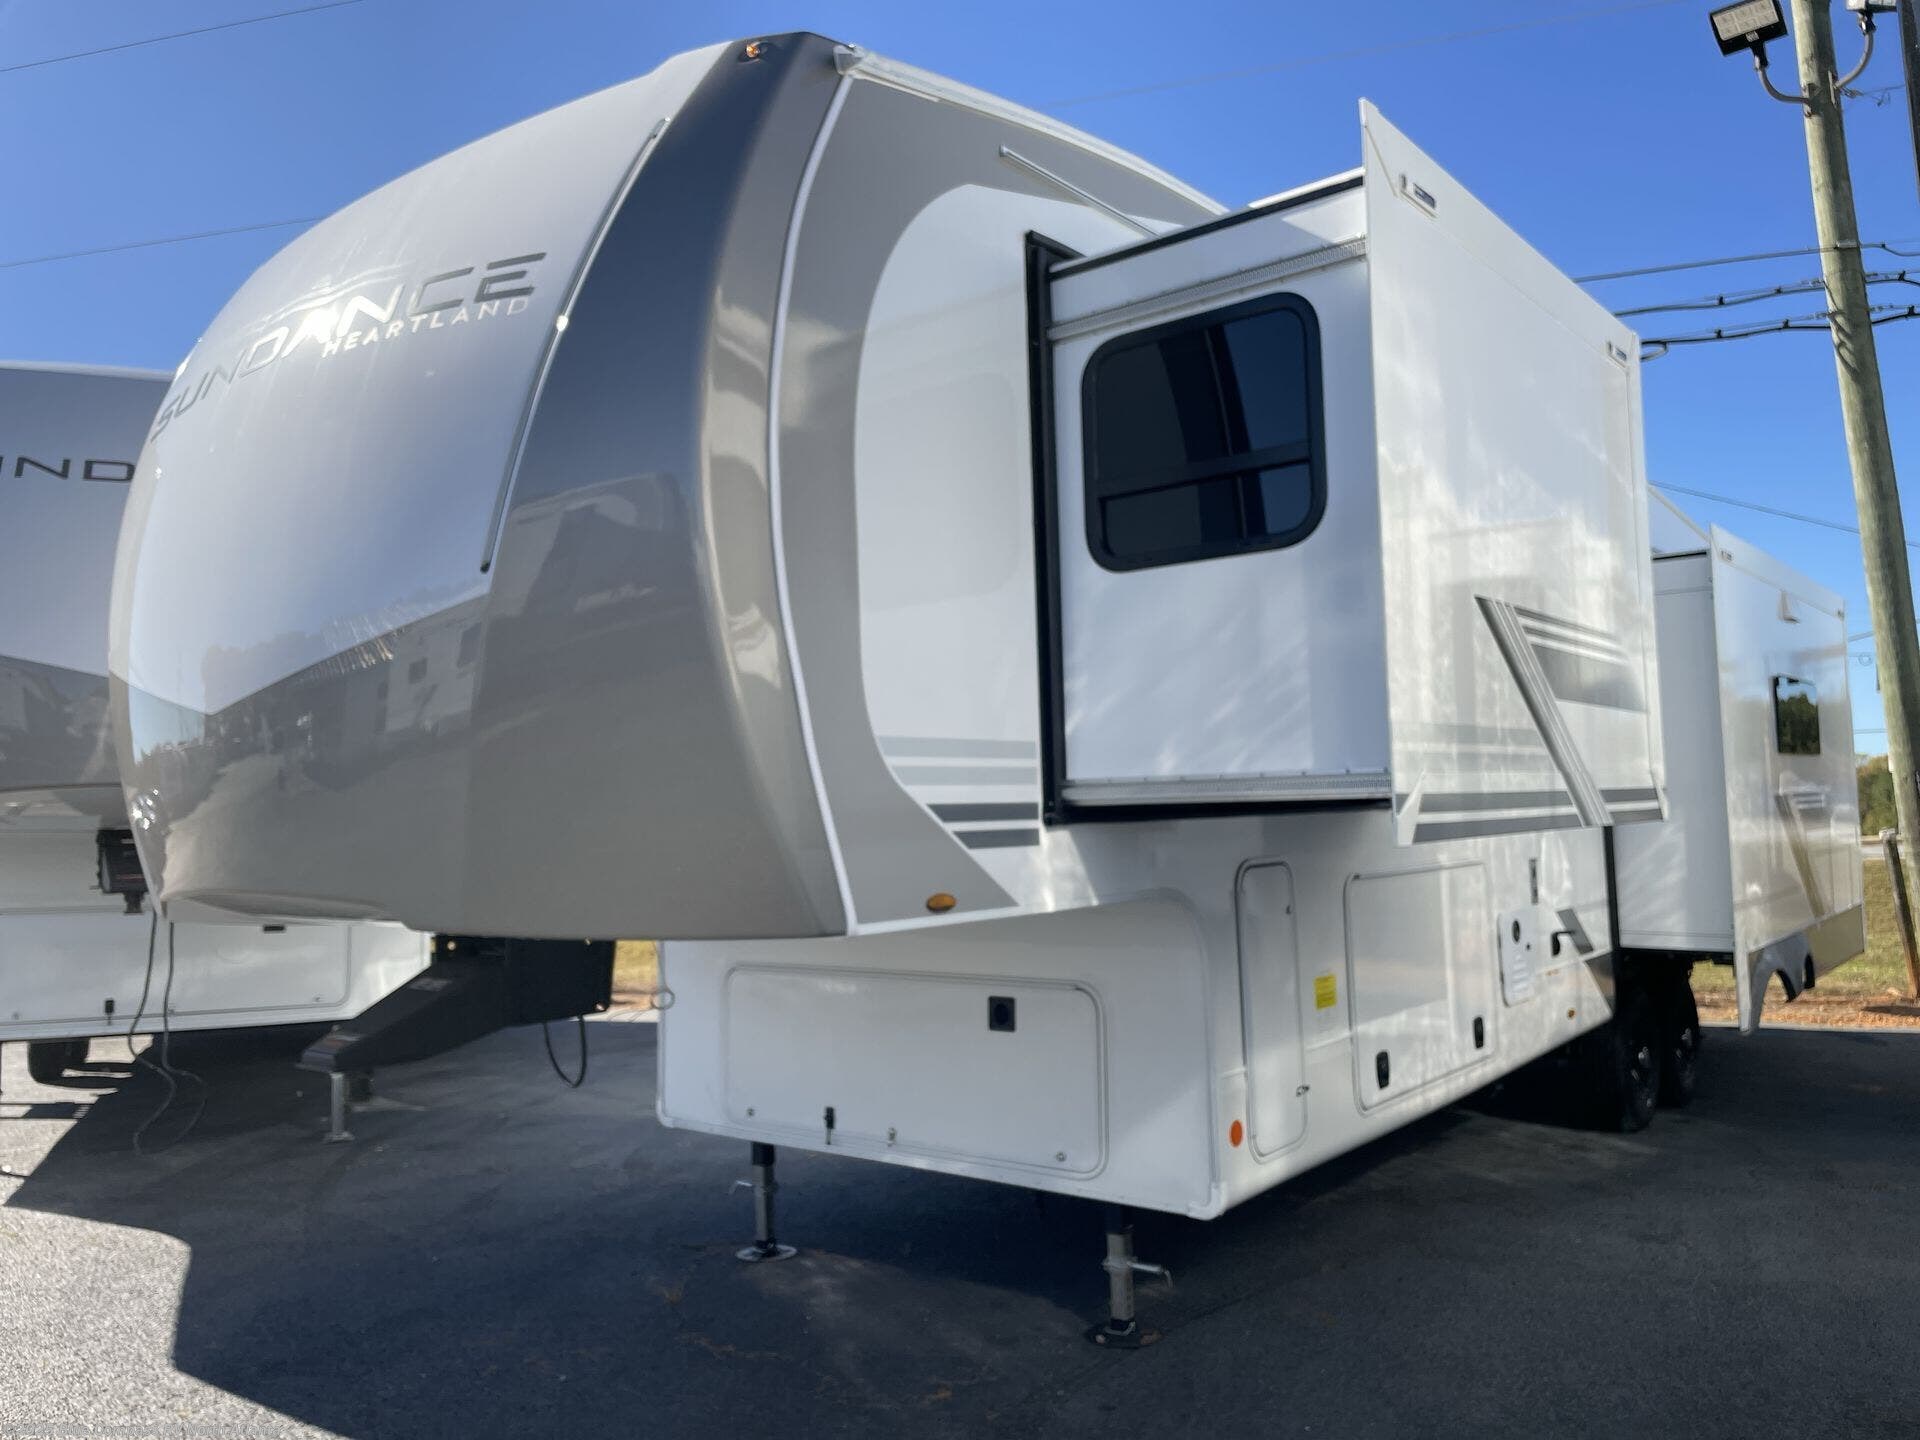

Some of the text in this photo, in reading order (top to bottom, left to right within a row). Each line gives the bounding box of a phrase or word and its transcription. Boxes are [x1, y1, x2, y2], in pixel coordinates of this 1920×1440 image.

[150, 252, 547, 443] SUNDANCE
[321, 297, 529, 358] HEARTLAND
[0, 456, 136, 482] ND
